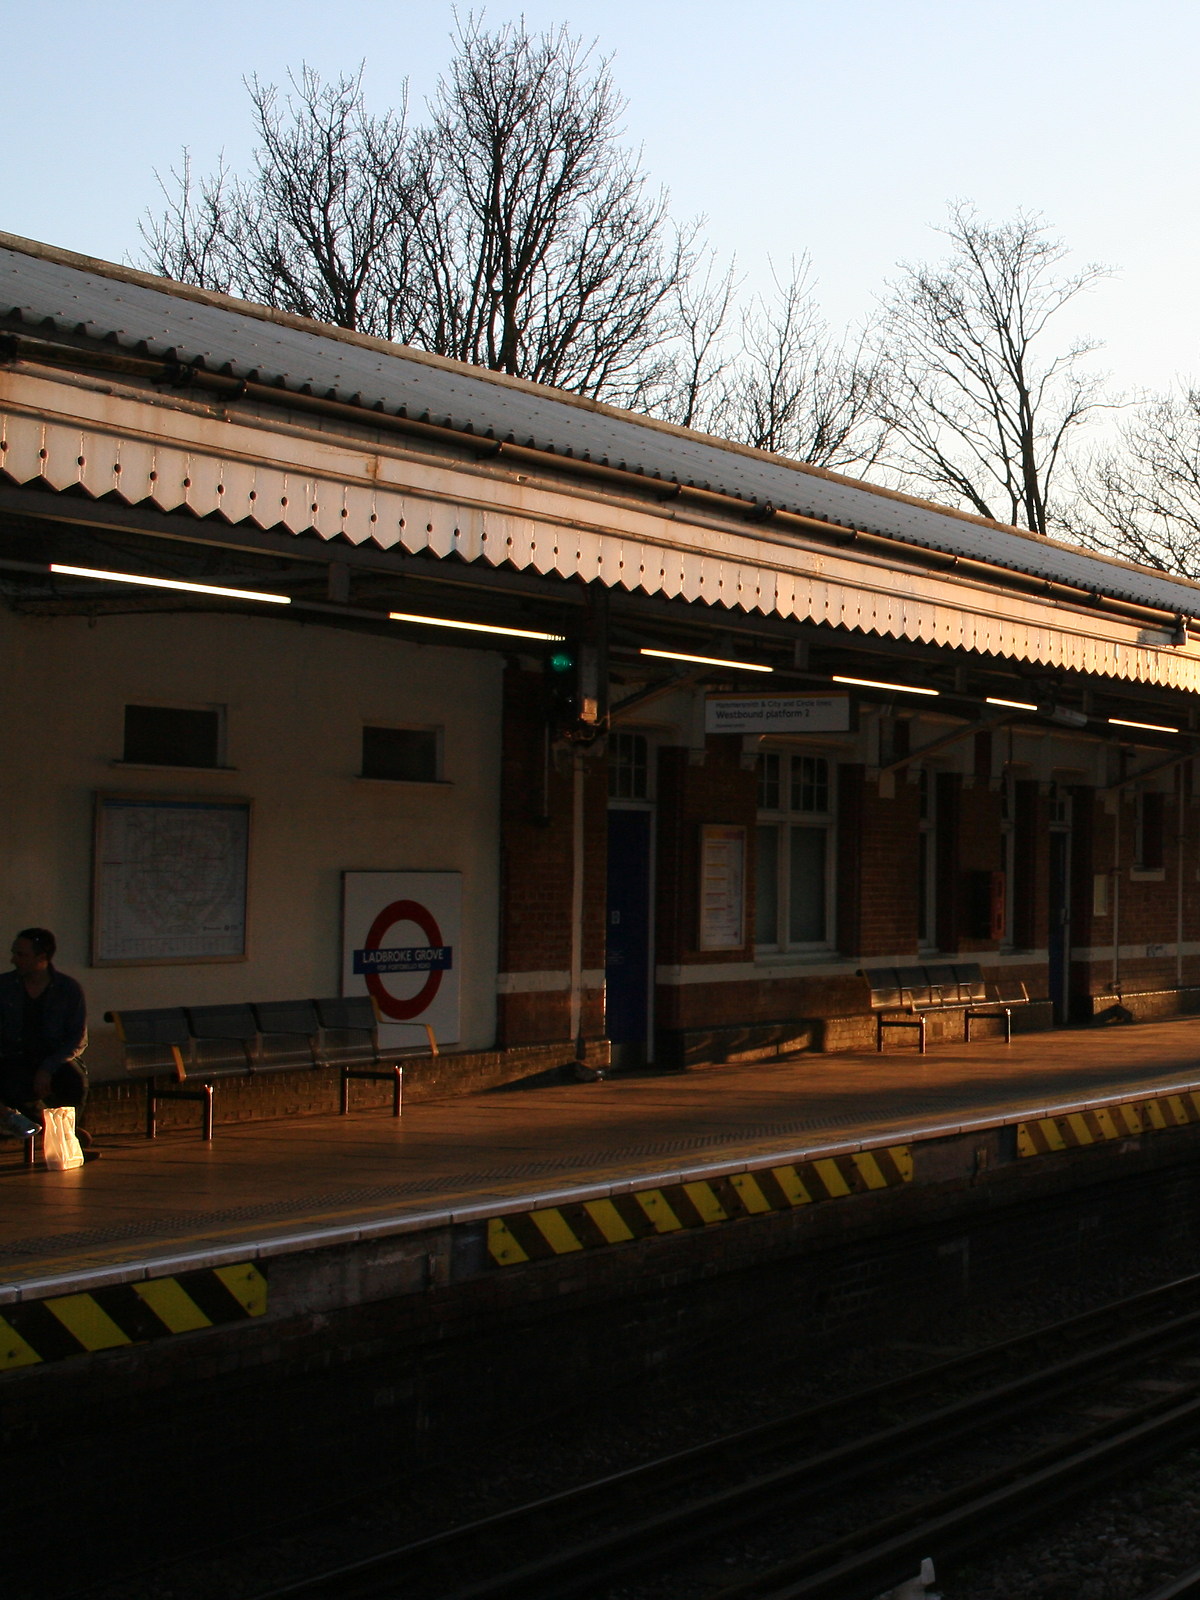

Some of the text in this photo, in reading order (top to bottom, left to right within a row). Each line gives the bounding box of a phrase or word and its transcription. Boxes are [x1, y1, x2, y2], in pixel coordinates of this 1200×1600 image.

[768, 700, 780, 708] City
[716, 708, 810, 720] Westbound platform 2
[362, 949, 444, 963] LADBROKE GROVE
